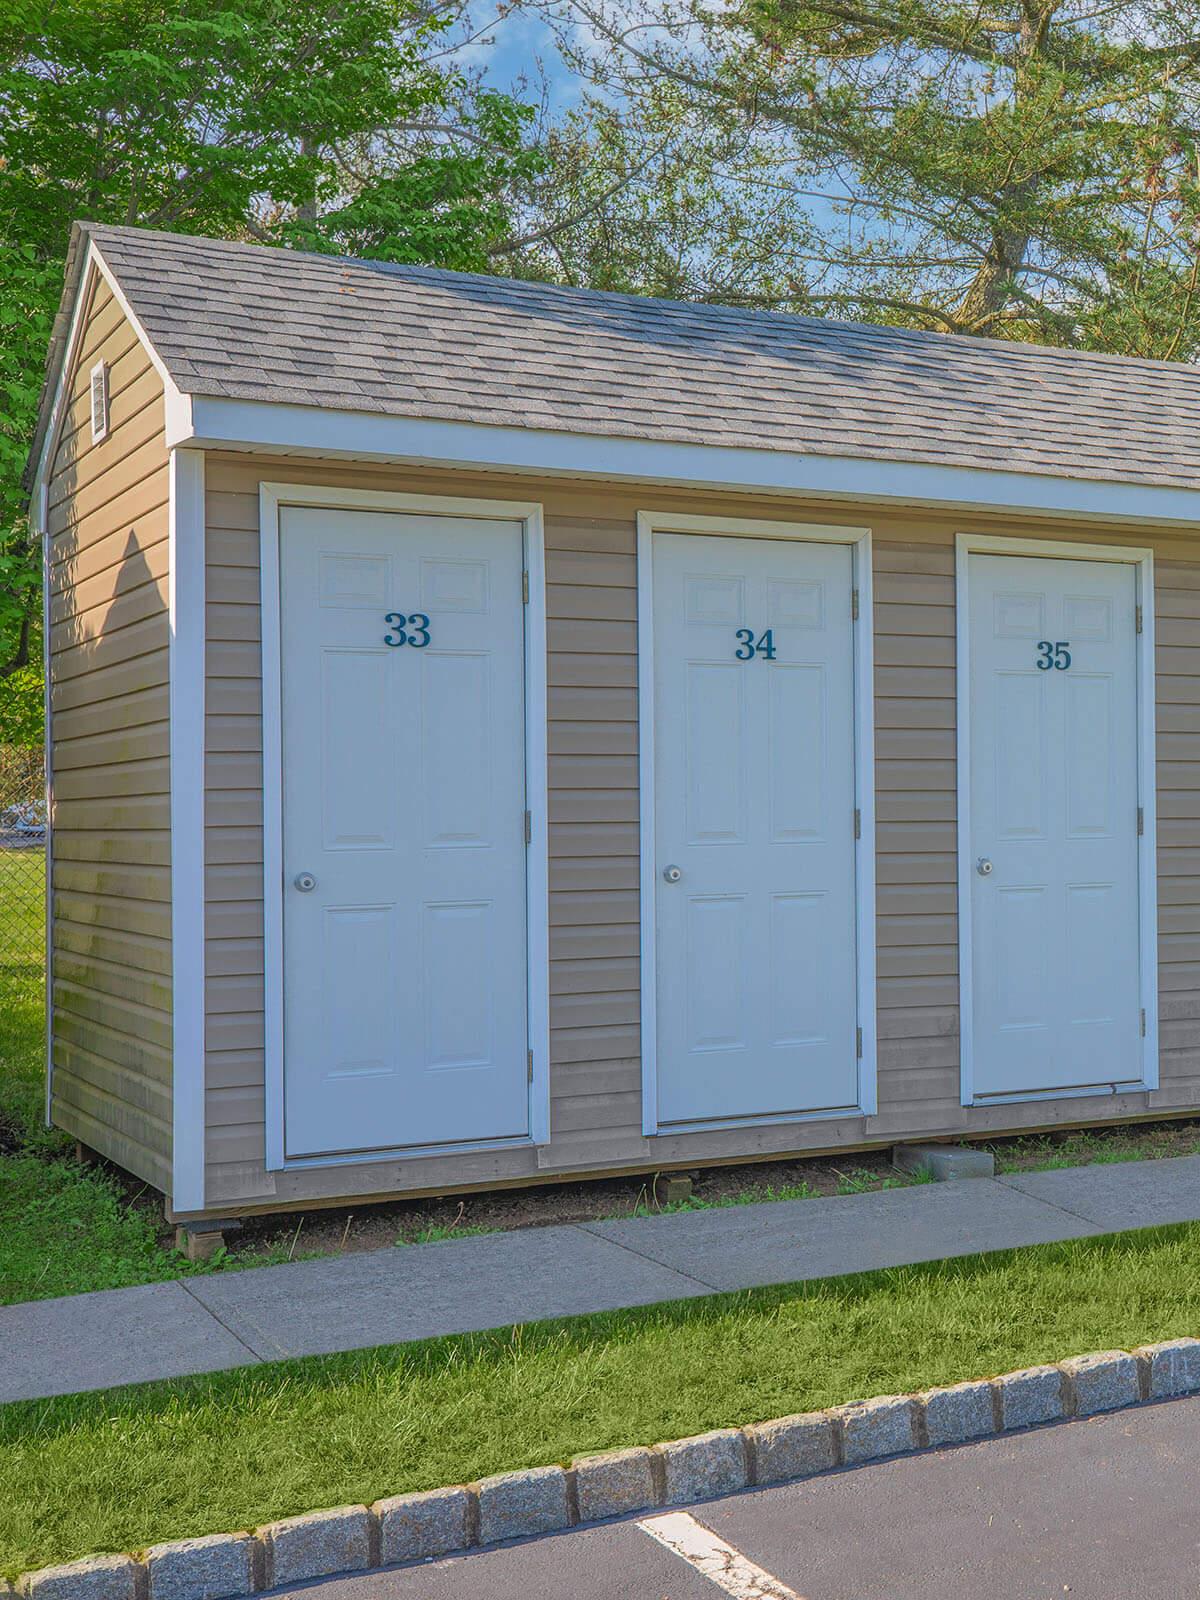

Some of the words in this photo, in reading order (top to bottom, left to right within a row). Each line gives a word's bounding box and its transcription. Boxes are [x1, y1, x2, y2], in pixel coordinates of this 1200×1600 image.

[383, 612, 432, 649] 33
[734, 628, 777, 661] 34
[1036, 640, 1072, 671] 35
